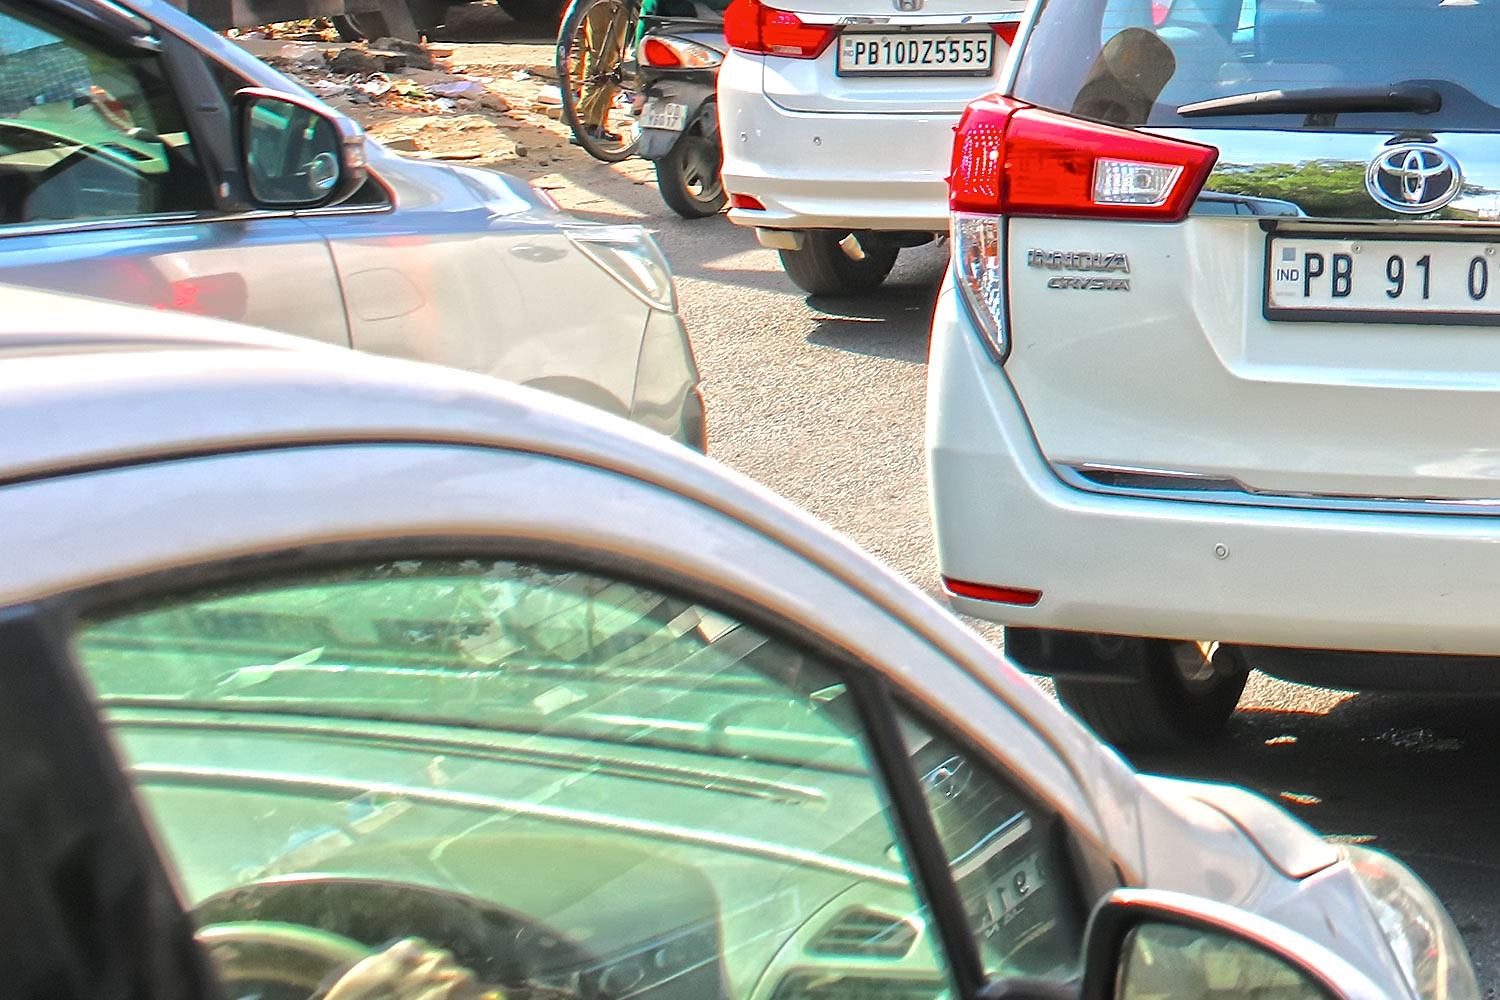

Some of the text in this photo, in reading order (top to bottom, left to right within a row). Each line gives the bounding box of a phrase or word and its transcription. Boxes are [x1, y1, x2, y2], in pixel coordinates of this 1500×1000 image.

[854, 40, 988, 65] PB10DZ5555
[1047, 276, 1131, 292] CRYSTA
[1276, 268, 1299, 281] IND
[1303, 252, 1353, 298] PB
[1385, 254, 1431, 300] 91
